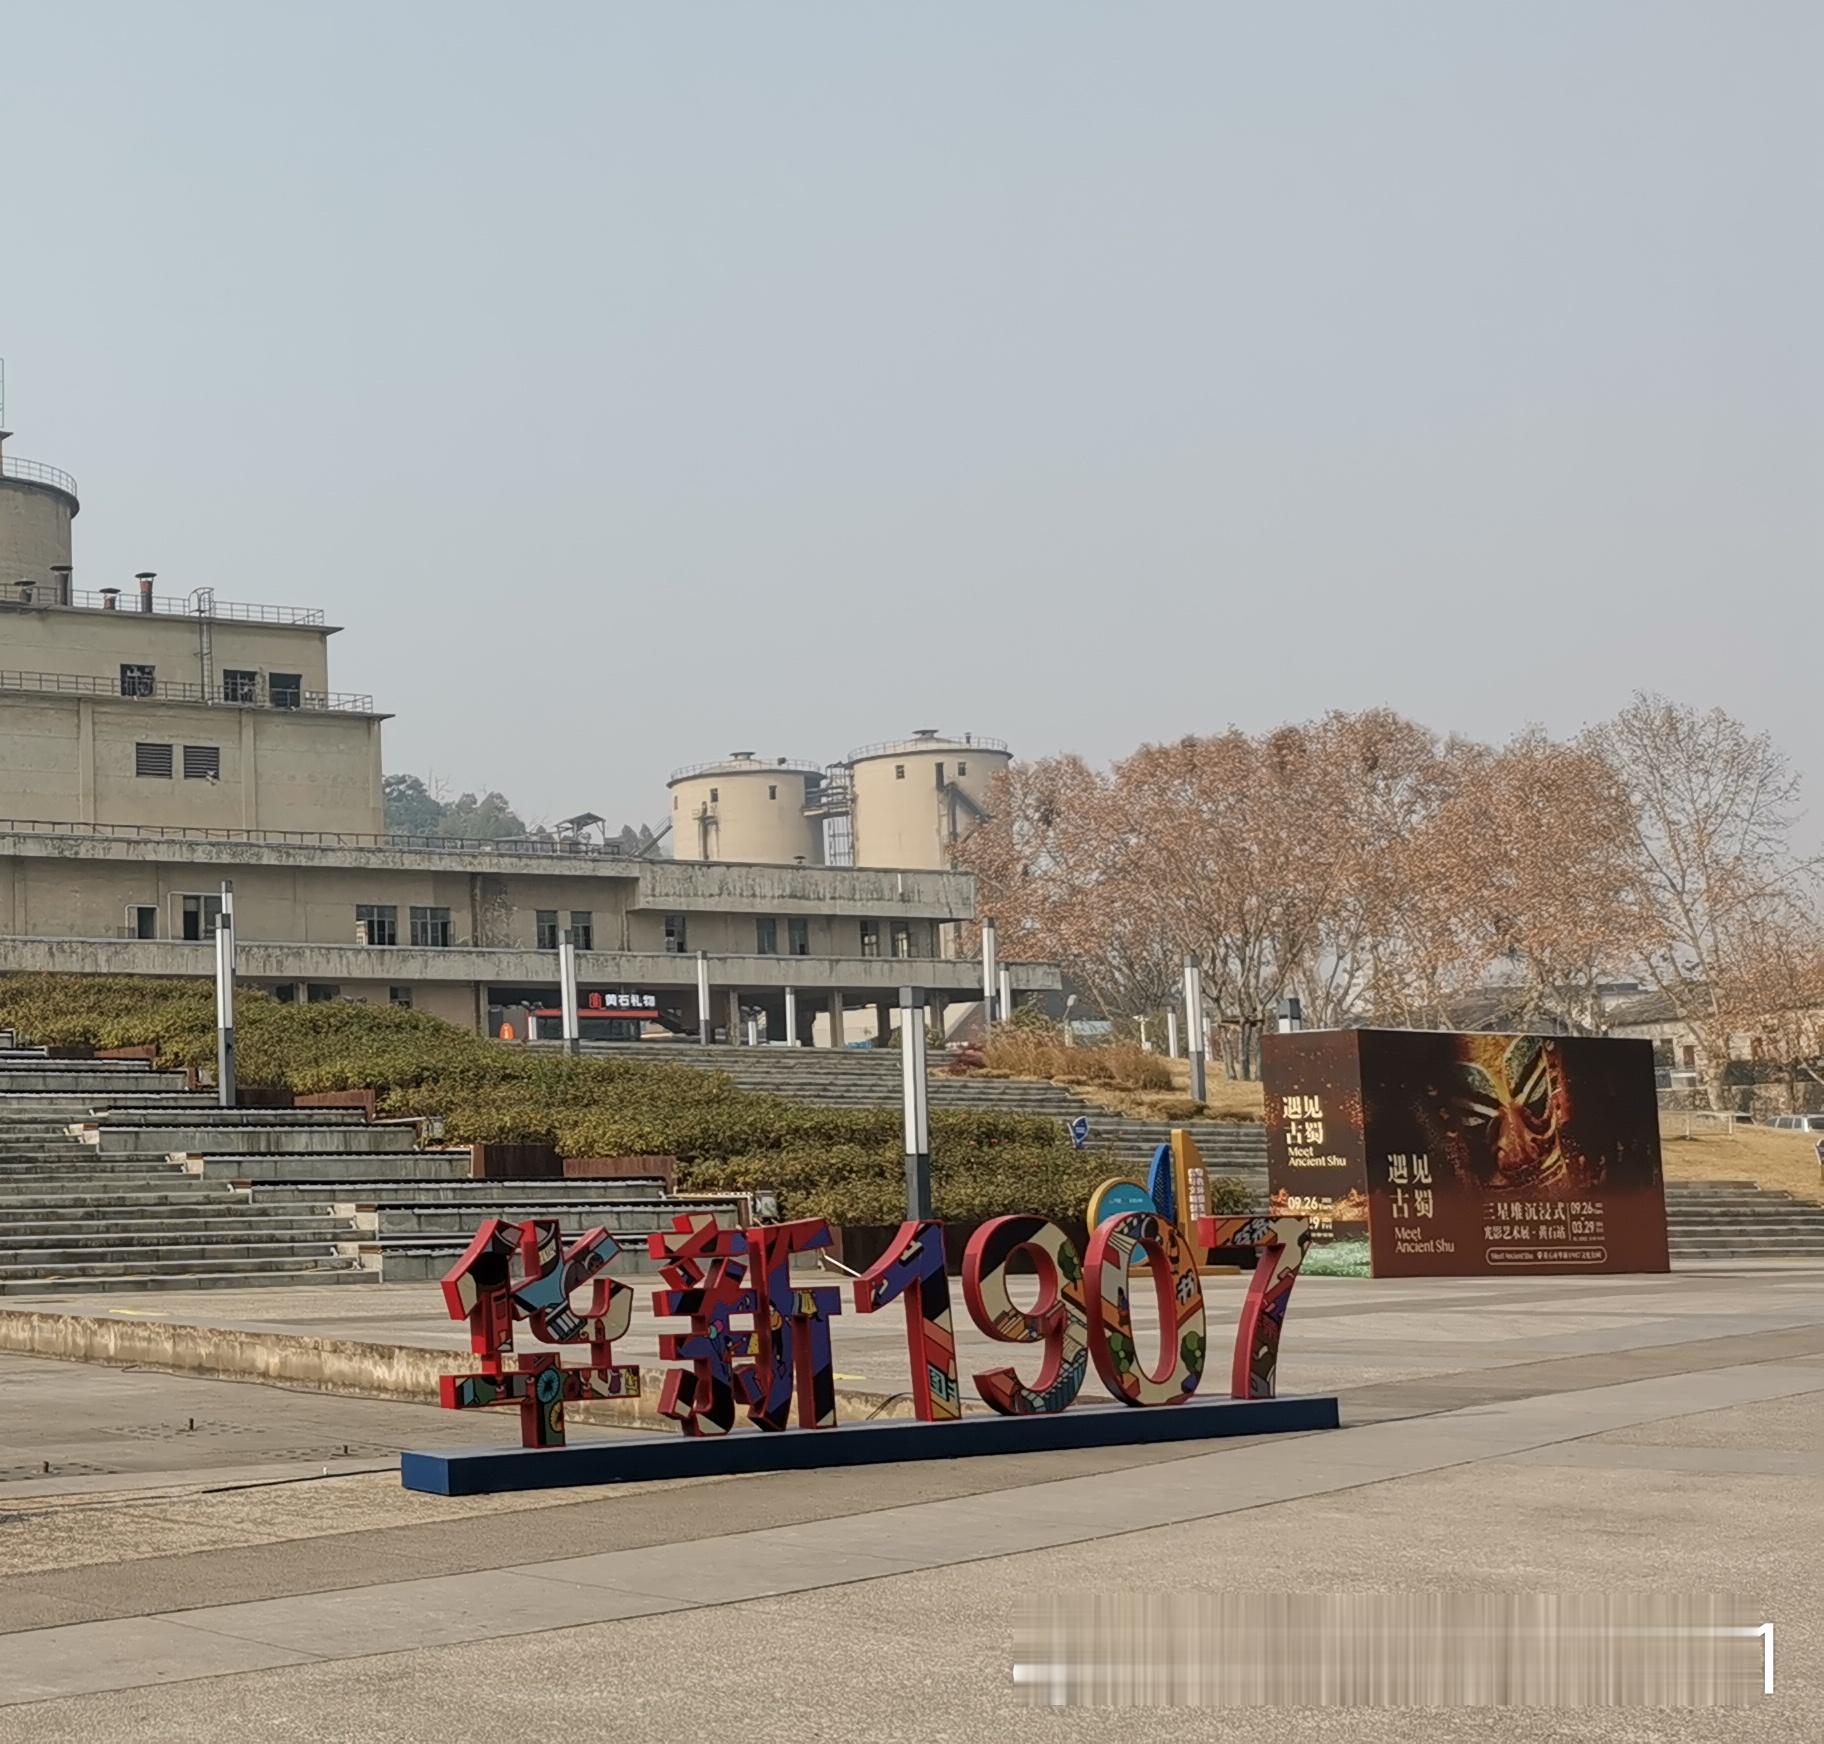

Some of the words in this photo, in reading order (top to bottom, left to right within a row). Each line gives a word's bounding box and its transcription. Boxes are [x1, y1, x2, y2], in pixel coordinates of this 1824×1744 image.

[605, 994, 655, 1007] 黄石礼物
[1282, 1095, 1323, 1119] 遇见
[1284, 1121, 1323, 1144] 古蜀
[1288, 1147, 1314, 1158] Meet
[1288, 1156, 1325, 1167] Ancient
[1327, 1155, 1346, 1166] Shu
[1388, 1154, 1432, 1184] 遇见
[1288, 1197, 1318, 1210] 09.26
[1389, 1188, 1433, 1218] 古蜀
[1570, 1201, 1593, 1214] 09.26
[1483, 1201, 1566, 1220] 三星堆沉浸式
[1395, 1227, 1422, 1241] Meet
[1571, 1221, 1594, 1233] 03.29
[1396, 1240, 1434, 1253] Ancient
[1436, 1238, 1454, 1253] Shu
[440, 1211, 1312, 1449] 华新1907
